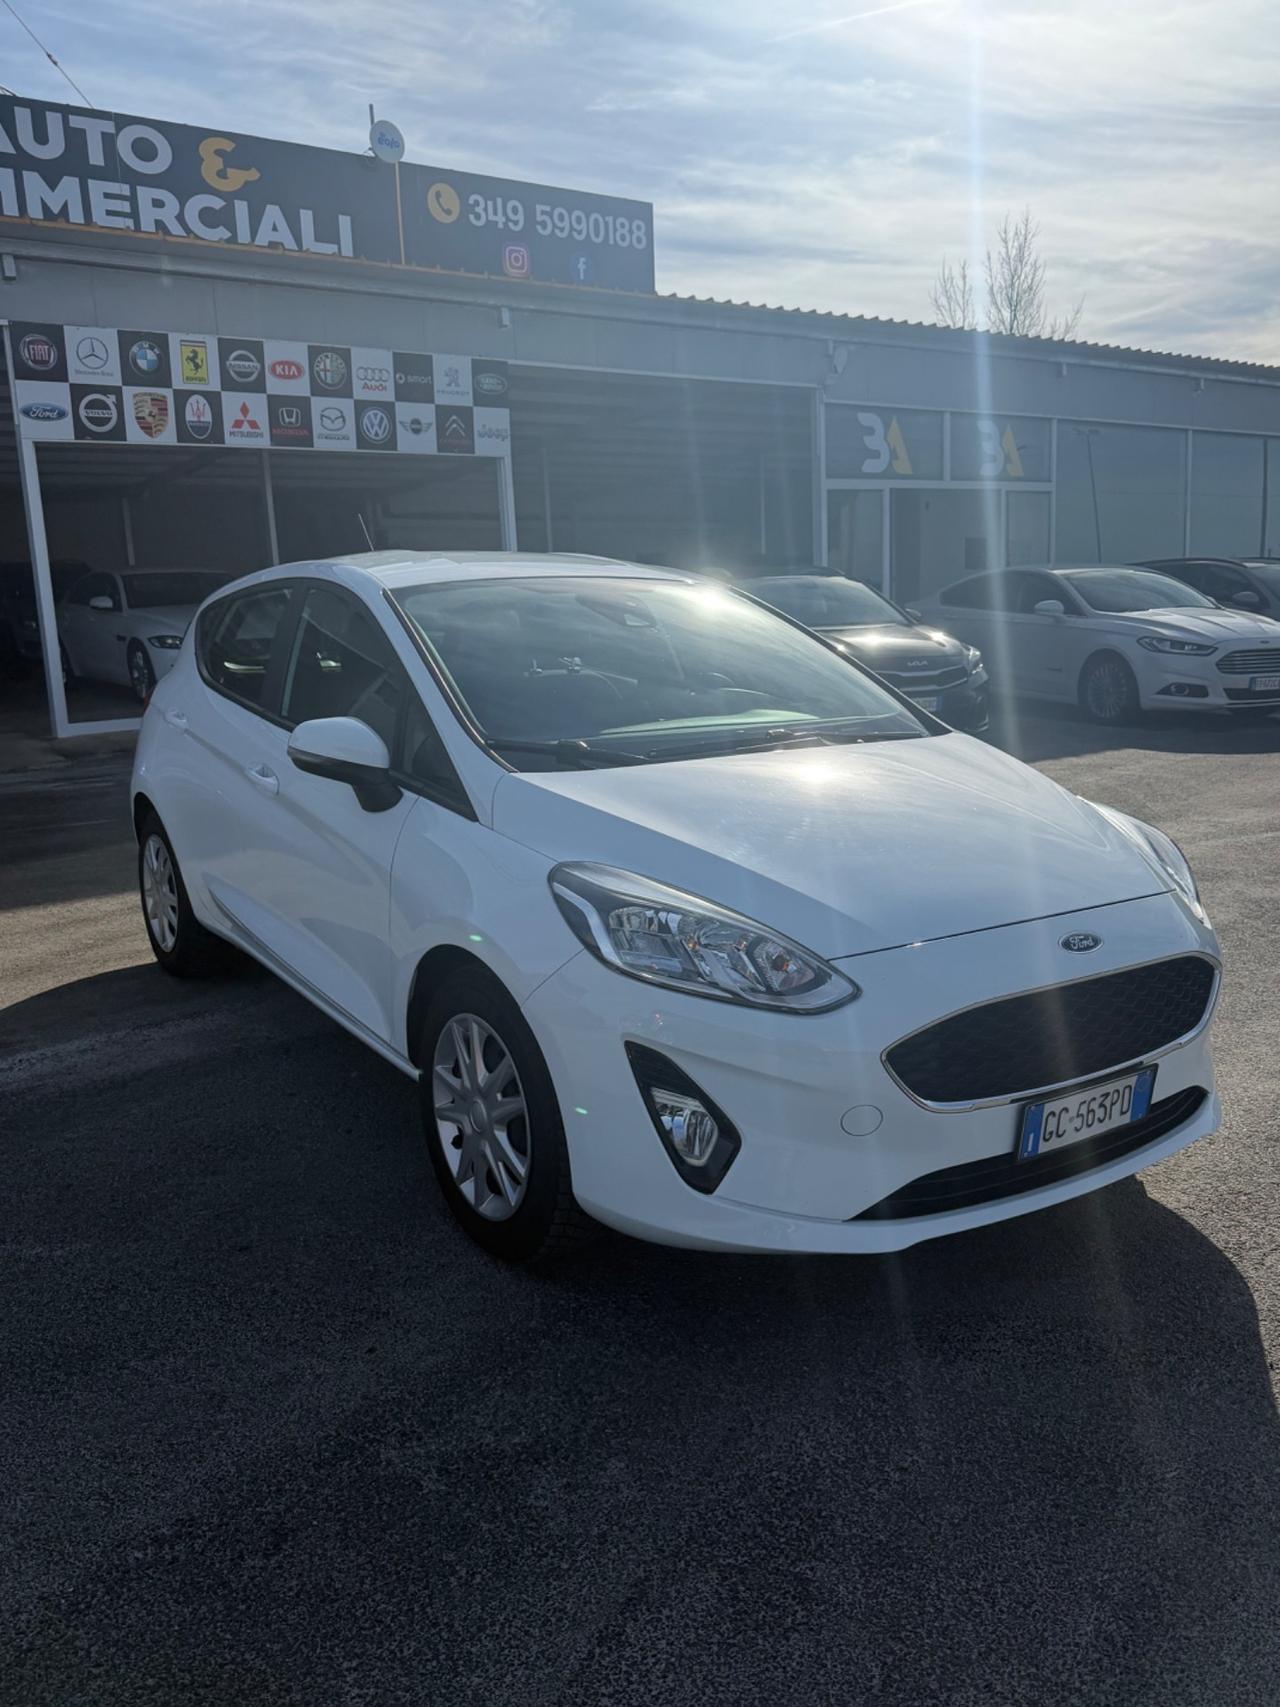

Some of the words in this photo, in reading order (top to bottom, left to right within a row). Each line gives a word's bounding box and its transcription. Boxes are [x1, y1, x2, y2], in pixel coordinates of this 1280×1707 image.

[199, 137, 260, 191] &
[468, 194, 524, 232] 349
[536, 205, 646, 249] 5990188
[29, 344, 49, 361] FIAT
[275, 364, 298, 376] KIA
[362, 382, 387, 391] Audi
[30, 406, 58, 418] Ford
[1069, 935, 1094, 950] Ford
